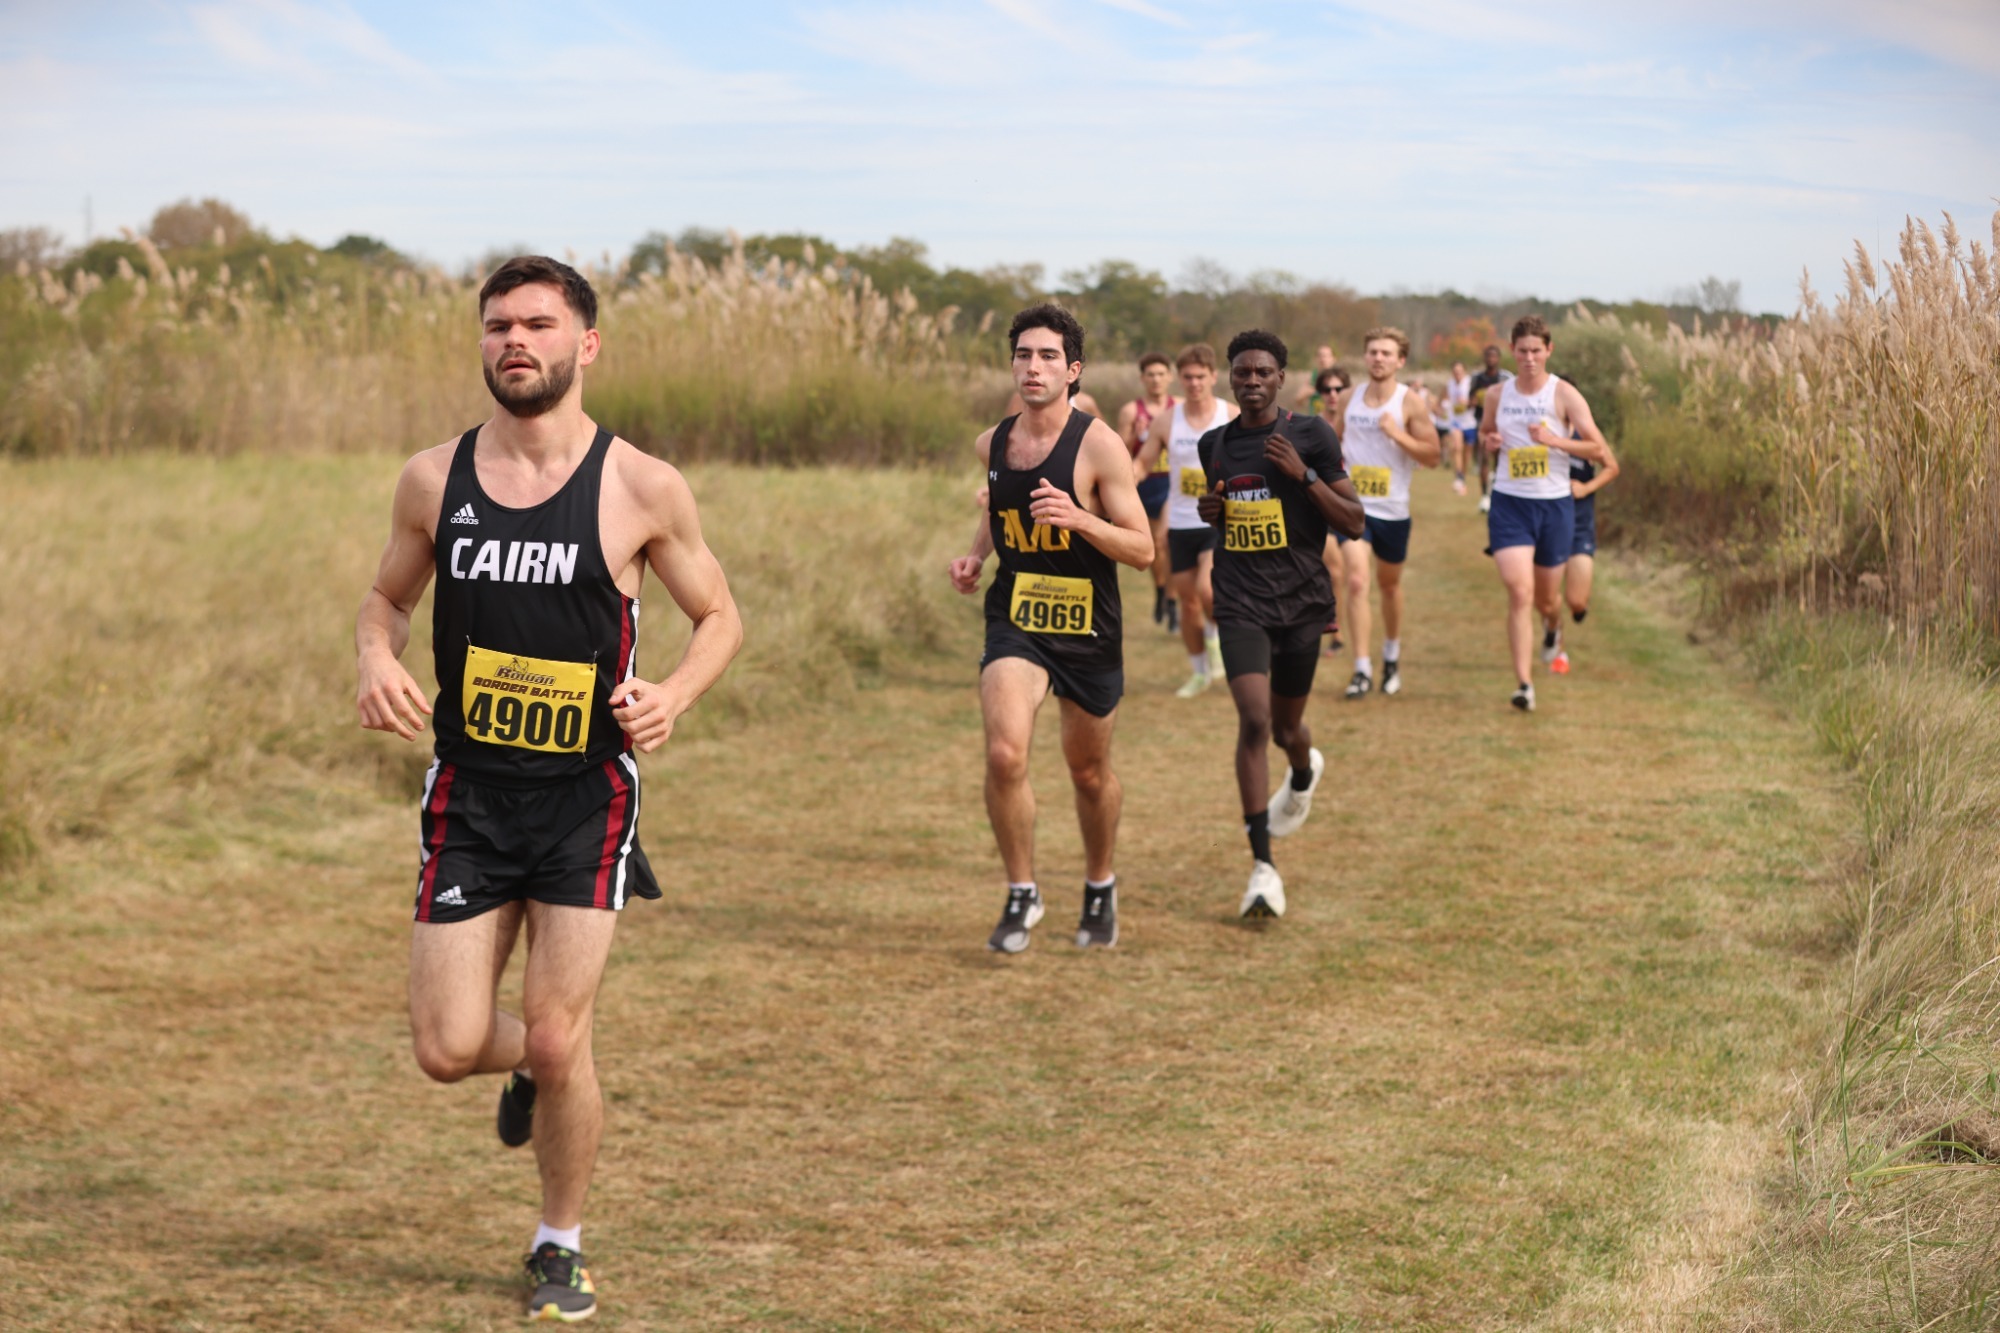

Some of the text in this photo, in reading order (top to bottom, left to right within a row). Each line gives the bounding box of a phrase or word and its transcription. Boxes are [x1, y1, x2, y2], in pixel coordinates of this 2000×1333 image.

[1512, 461, 1545, 478] 5231
[450, 515, 480, 526] adidas
[1227, 522, 1282, 549] 5056
[450, 537, 580, 585] CAIRN
[1053, 594, 1088, 602] BATTLE
[1015, 600, 1087, 631] 4969
[472, 676, 587, 701] BORDER BATTLE
[495, 665, 557, 687] Rowan
[467, 691, 583, 750] 4900
